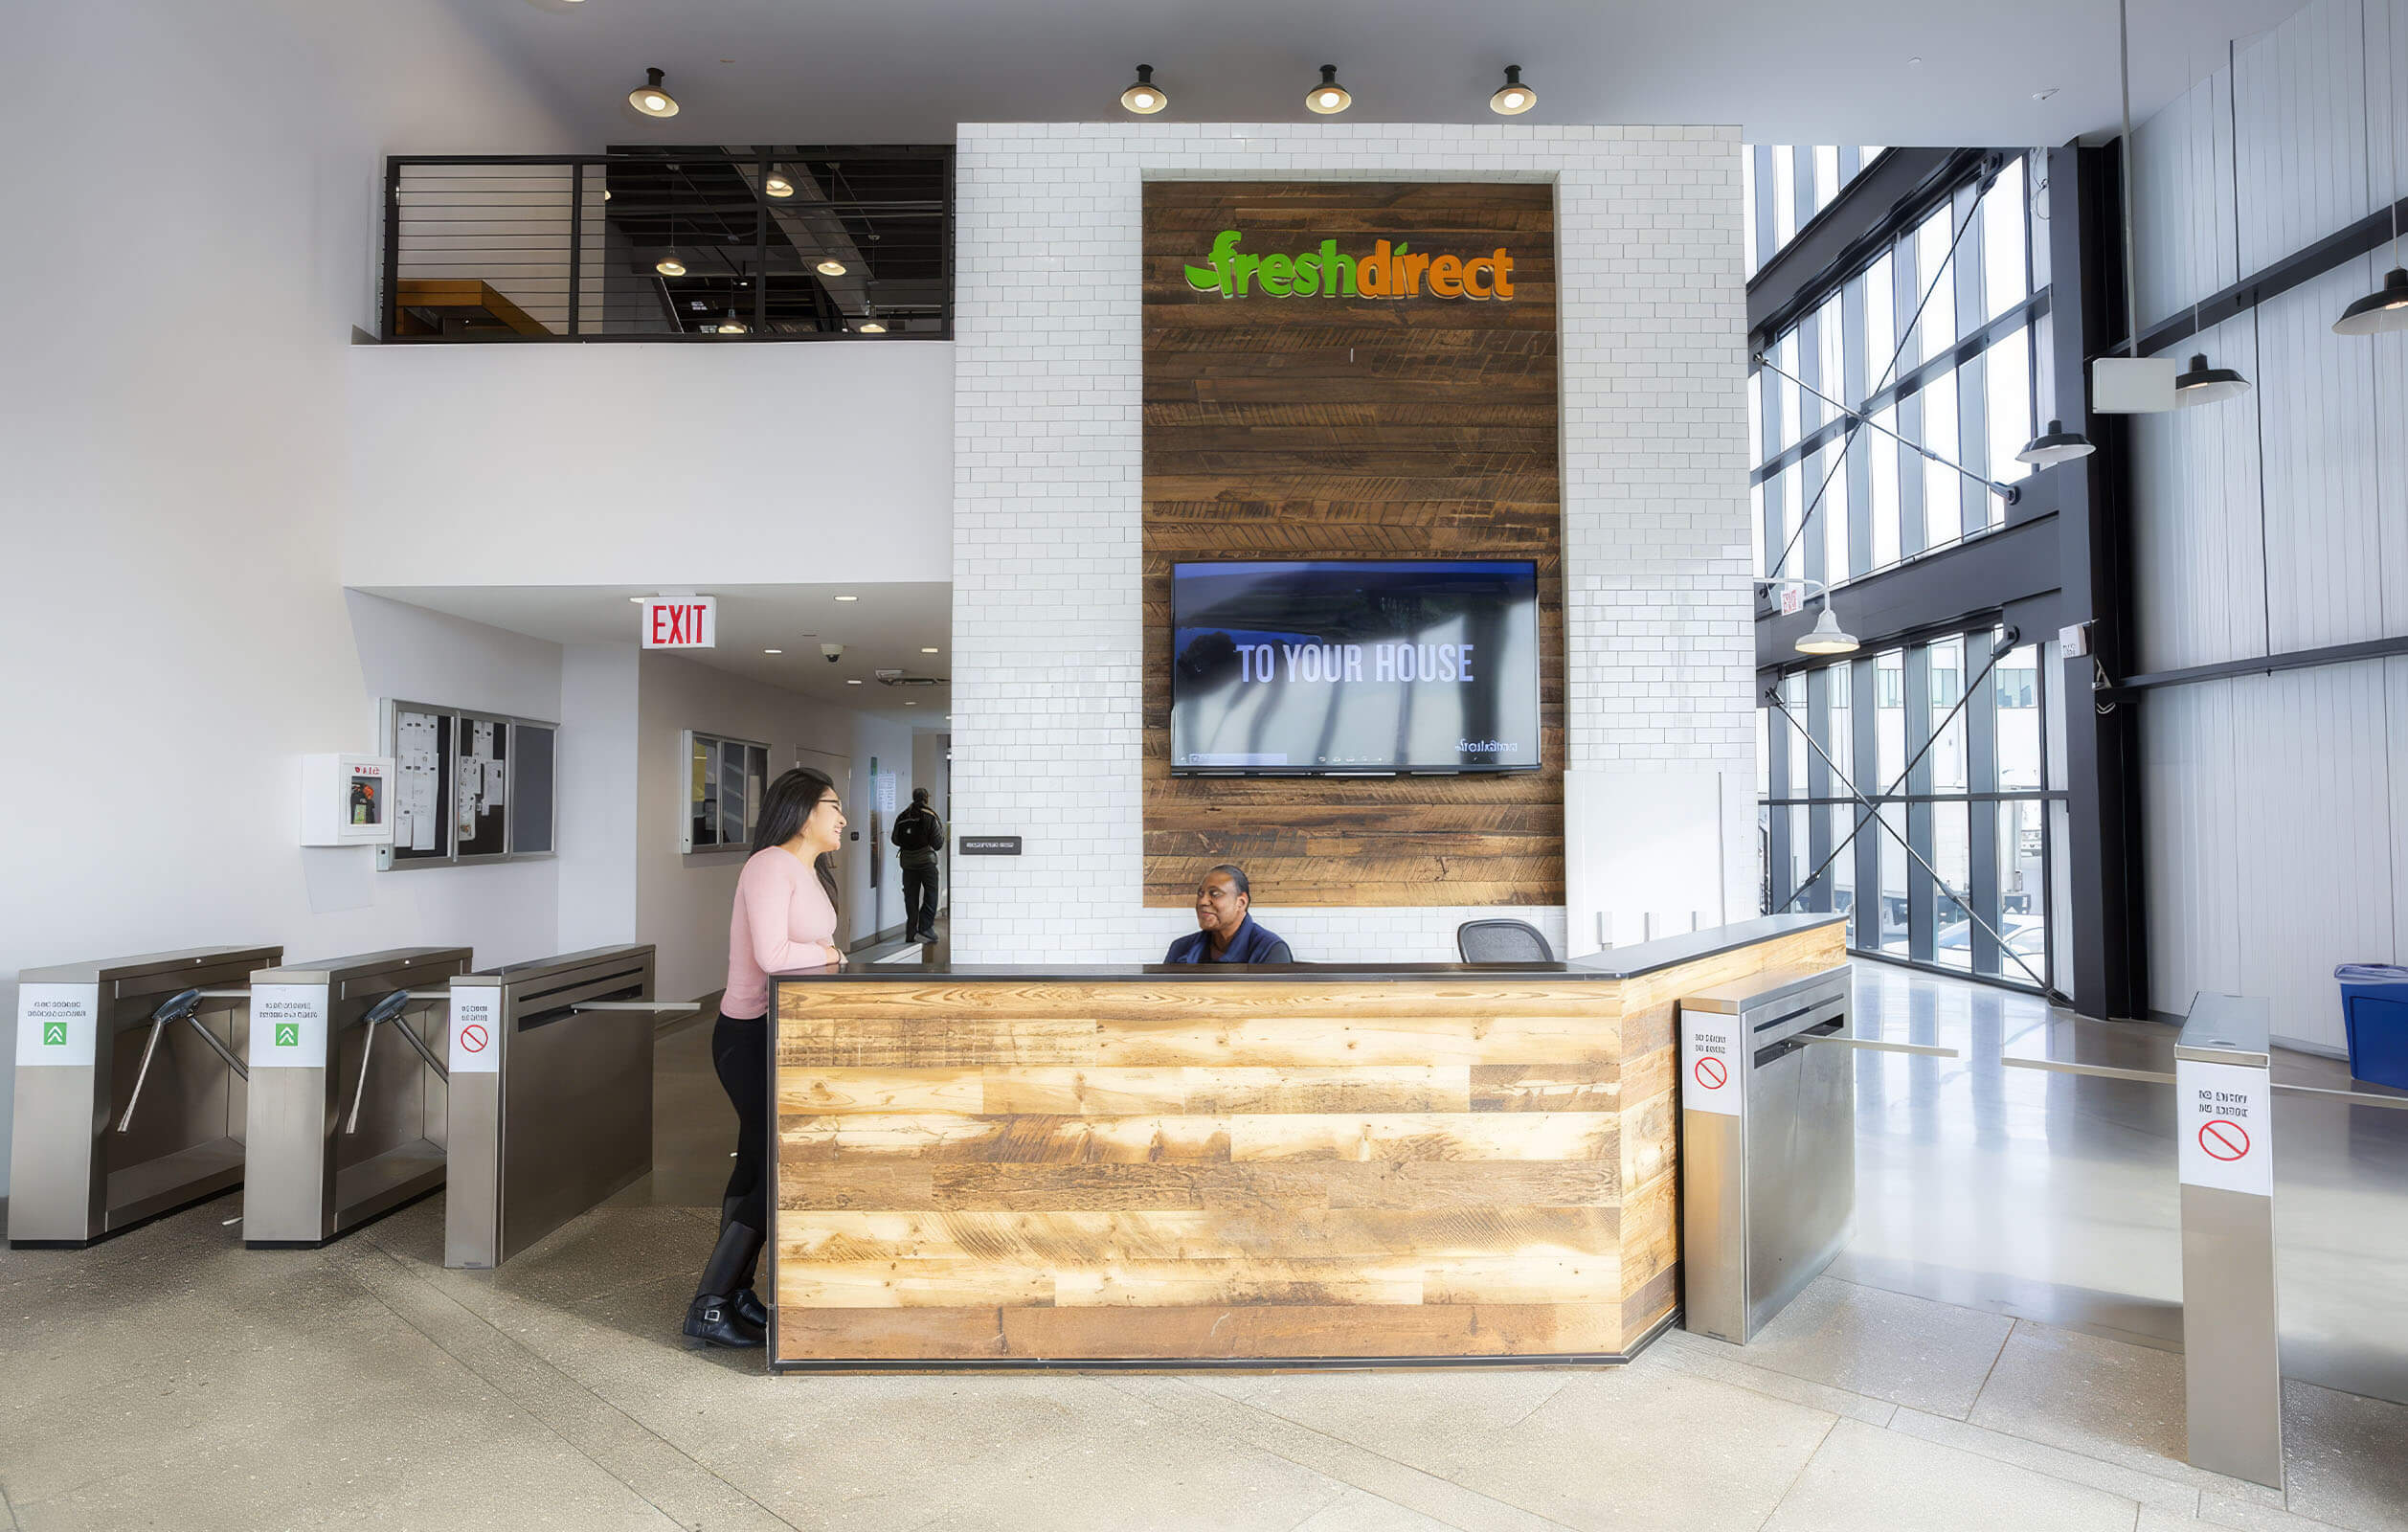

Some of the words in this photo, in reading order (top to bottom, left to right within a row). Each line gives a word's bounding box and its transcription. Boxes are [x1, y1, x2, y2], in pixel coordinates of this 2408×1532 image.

[1185, 230, 1515, 301] freshdirect
[652, 604, 707, 644] EXIT
[1235, 643, 1275, 683] TO
[1282, 643, 1363, 683] YOUR
[1376, 643, 1474, 683] HOUSE
